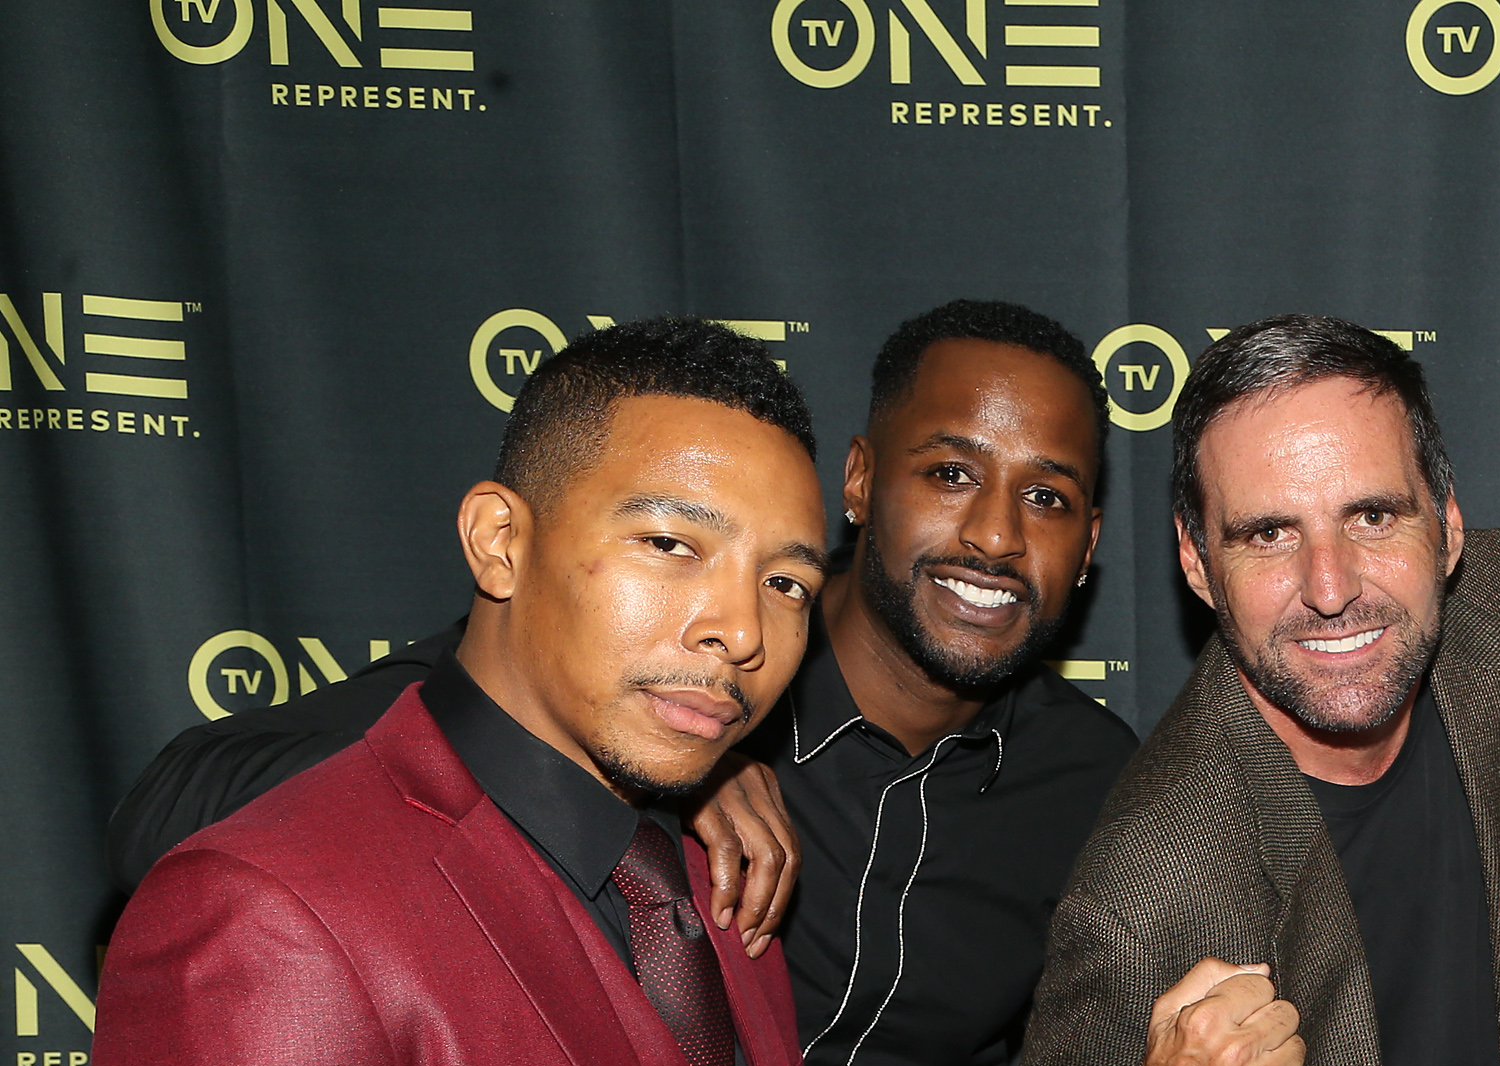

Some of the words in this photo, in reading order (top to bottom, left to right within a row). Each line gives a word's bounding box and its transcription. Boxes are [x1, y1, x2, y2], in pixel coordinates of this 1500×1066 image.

[771, 0, 1101, 89] ONE
[801, 19, 844, 47] TV
[1437, 25, 1480, 54] TV
[272, 83, 486, 112] REPRESENT.
[890, 101, 1112, 127] REPRESENT.
[499, 348, 543, 376] TV
[1118, 364, 1161, 391] TV
[220, 667, 263, 695] TV
